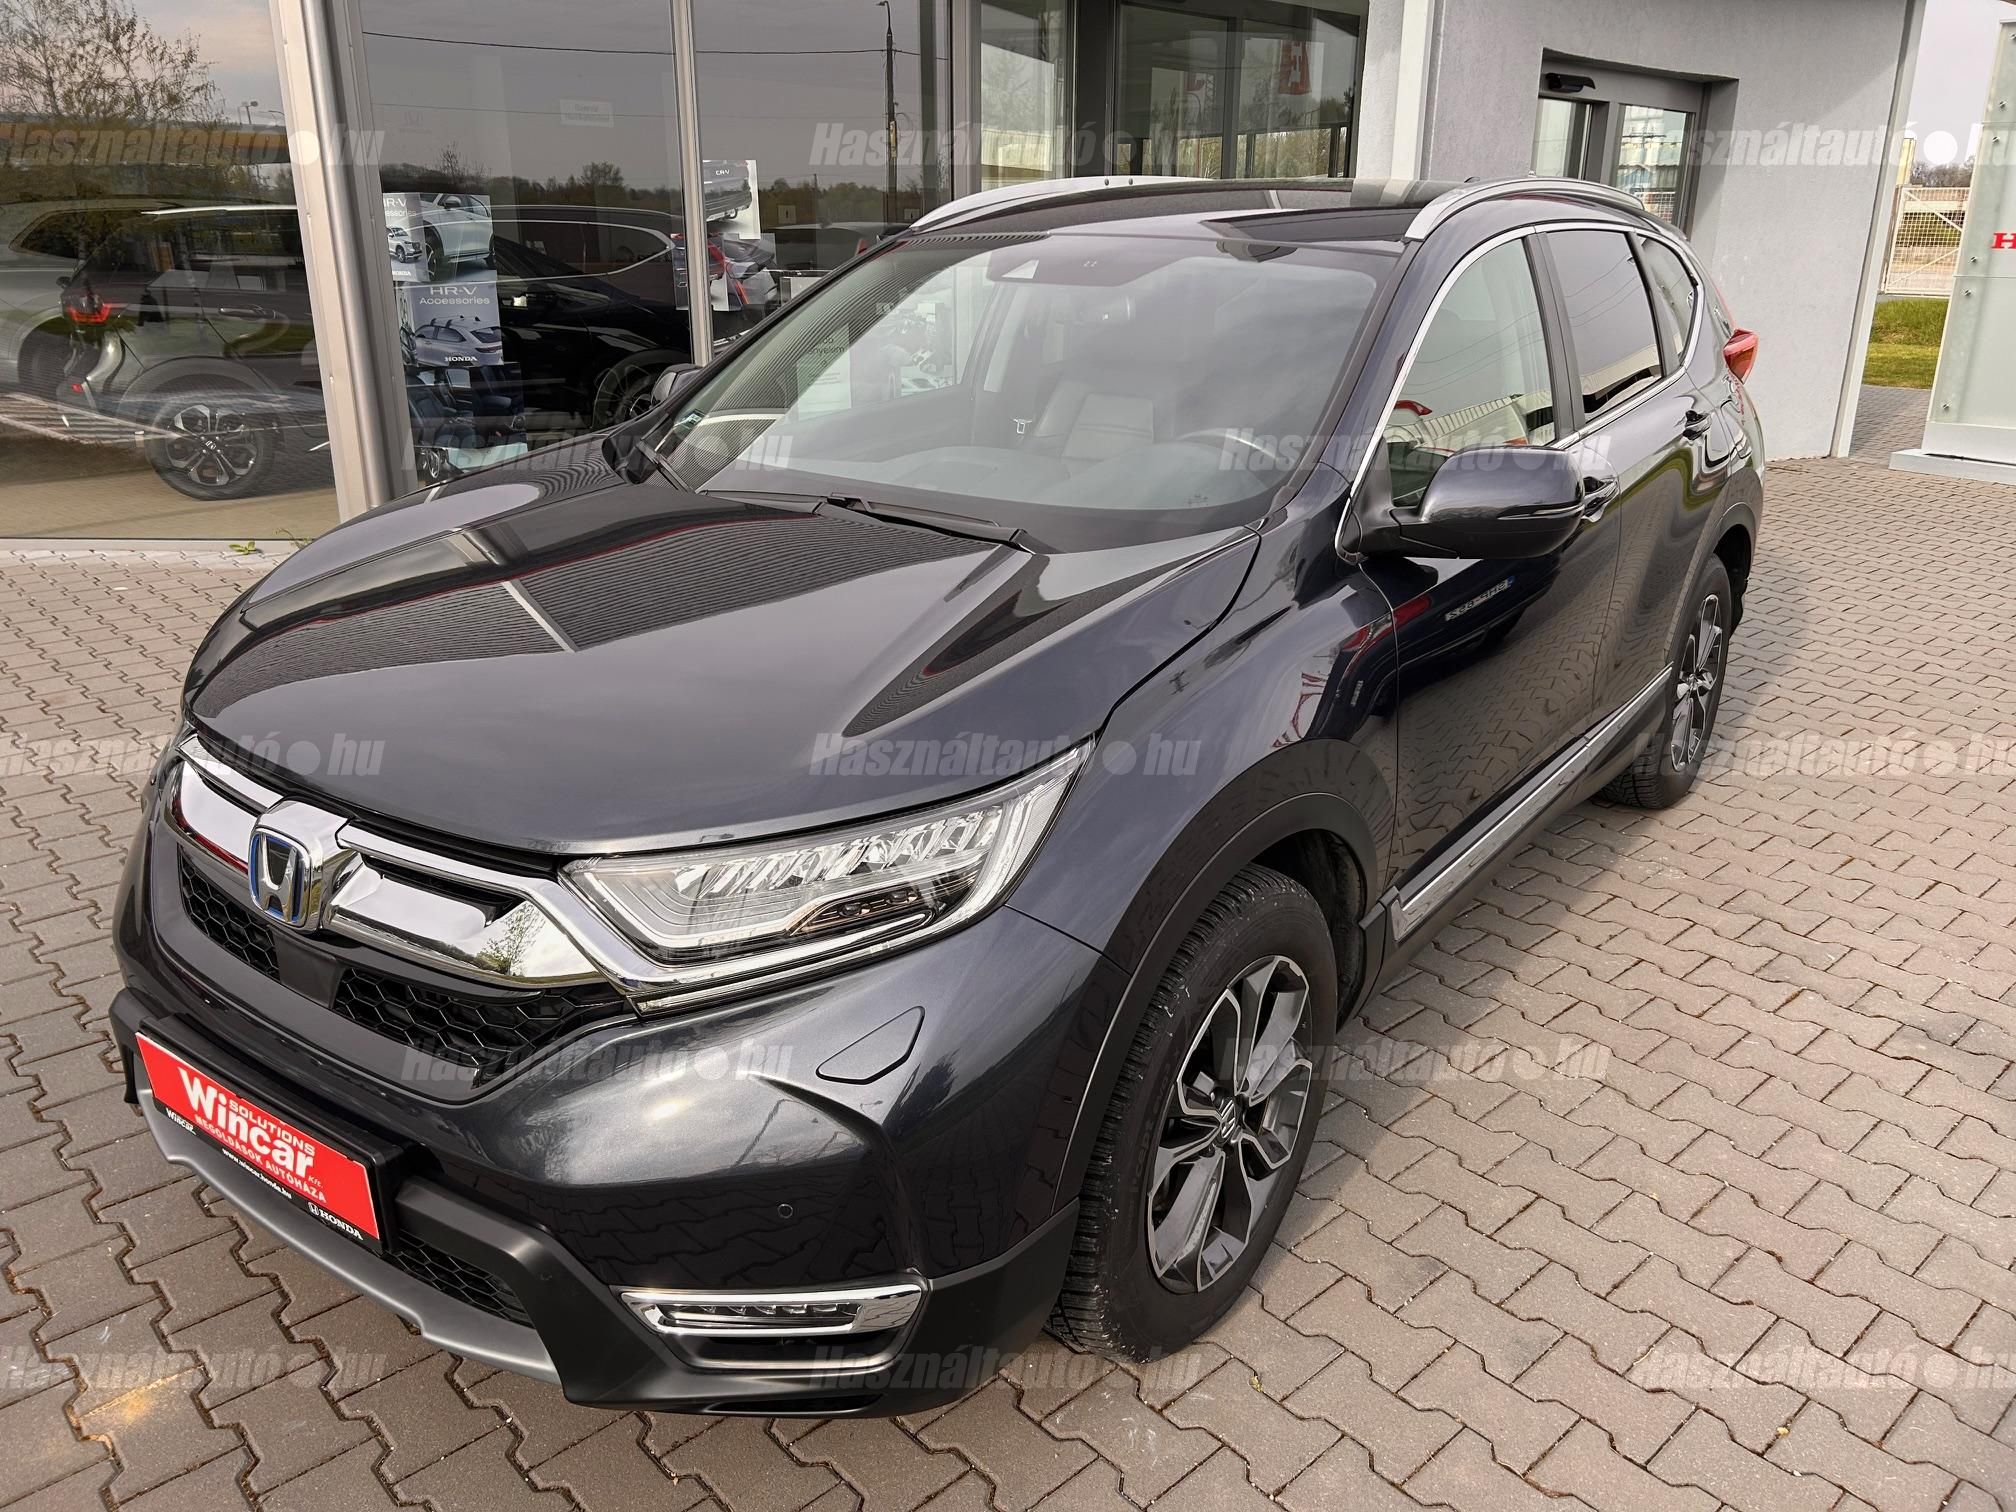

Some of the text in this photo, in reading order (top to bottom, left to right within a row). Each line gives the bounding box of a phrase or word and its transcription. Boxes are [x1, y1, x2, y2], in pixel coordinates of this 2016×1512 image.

[419, 296, 491, 305] Accessories
[430, 286, 478, 296] HR-V
[177, 1066, 314, 1178] Wincar
[229, 1099, 316, 1156] SOLUTIONS
[318, 1208, 364, 1241] HONDA
